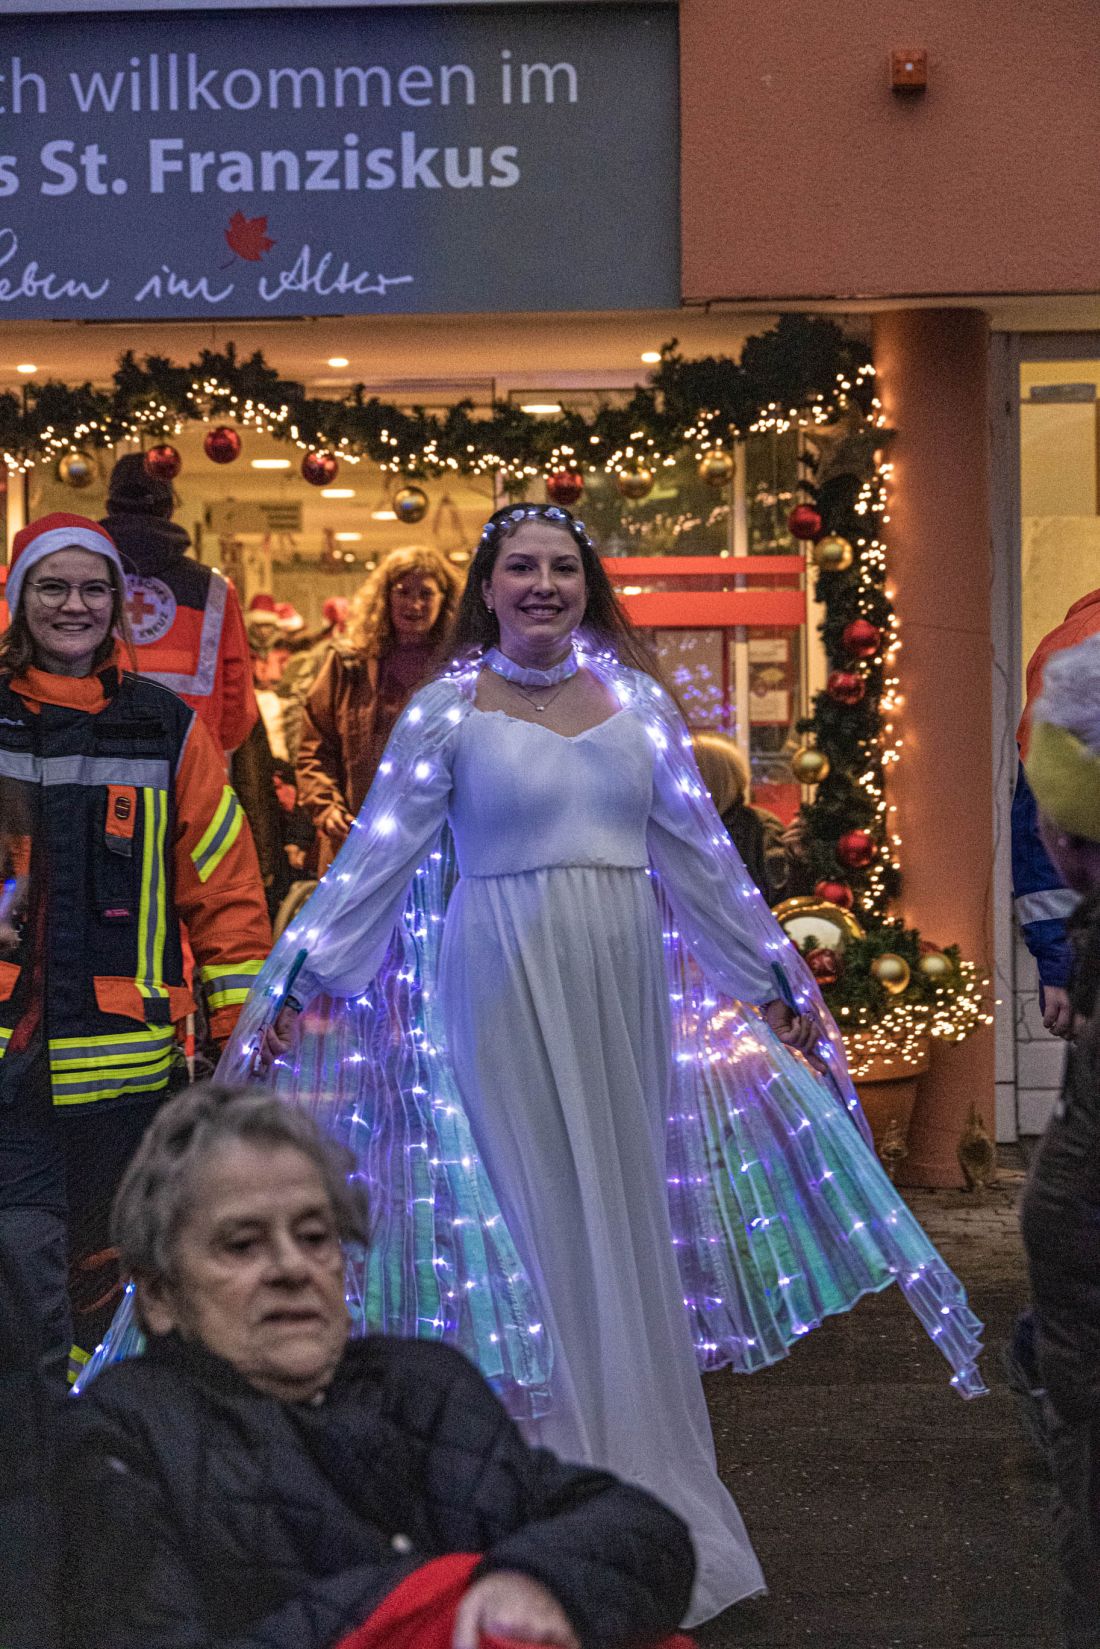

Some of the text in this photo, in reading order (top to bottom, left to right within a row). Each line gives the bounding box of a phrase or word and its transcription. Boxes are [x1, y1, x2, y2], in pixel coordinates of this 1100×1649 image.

[0, 50, 578, 114] h willkommen im
[40, 139, 129, 196] St.
[148, 130, 521, 194] Franziskus
[133, 263, 235, 304] im
[257, 243, 415, 302] Alter
